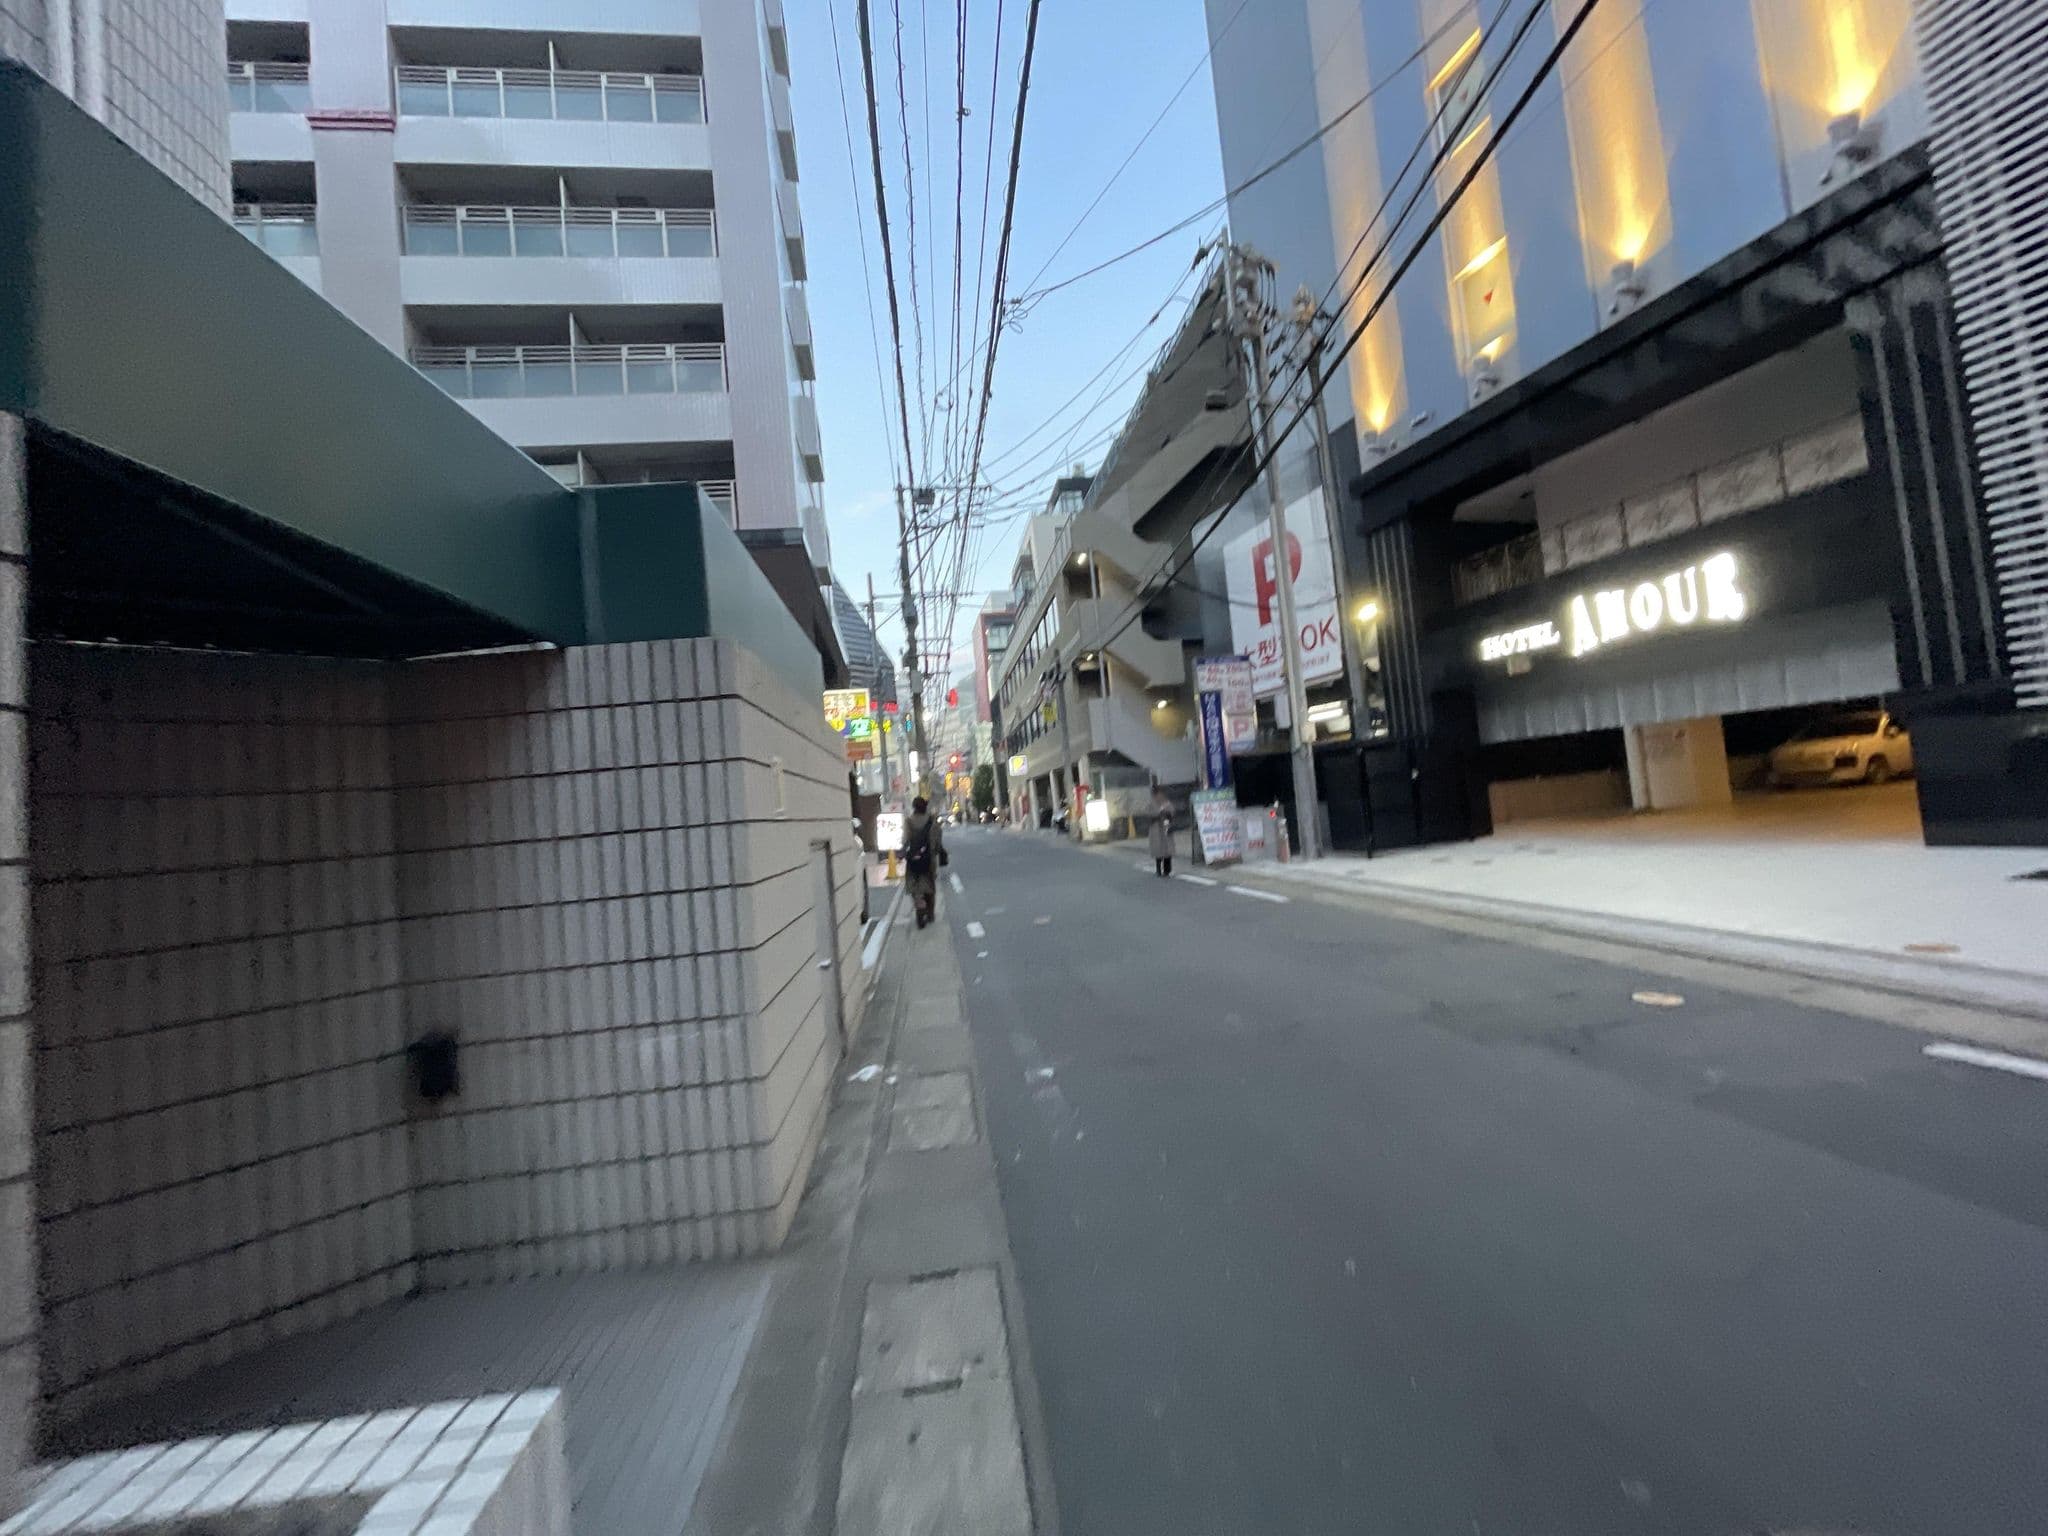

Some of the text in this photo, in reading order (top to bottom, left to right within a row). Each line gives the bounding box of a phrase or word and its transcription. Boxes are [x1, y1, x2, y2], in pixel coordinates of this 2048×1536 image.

[1252, 530, 1303, 628] P
[1480, 552, 1745, 661] HOTEL AMOUR
[1300, 614, 1337, 652] OK
